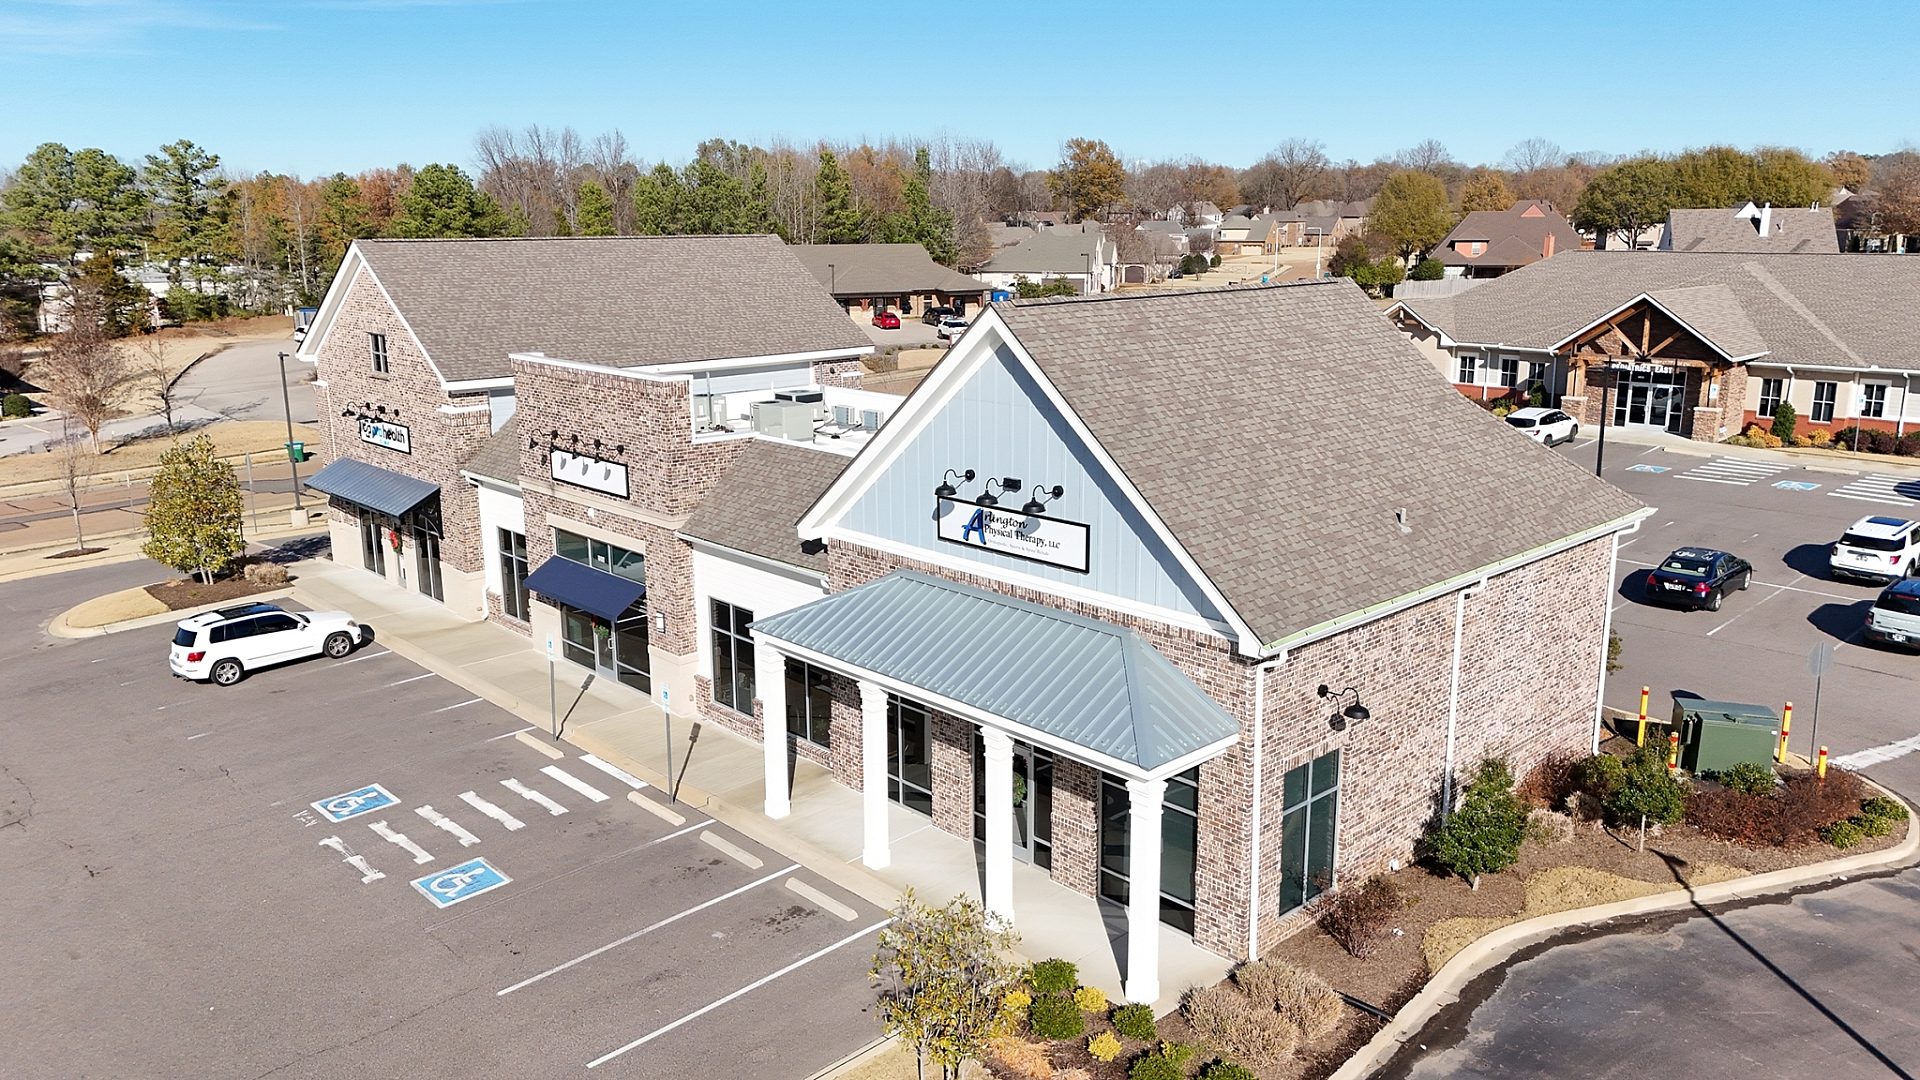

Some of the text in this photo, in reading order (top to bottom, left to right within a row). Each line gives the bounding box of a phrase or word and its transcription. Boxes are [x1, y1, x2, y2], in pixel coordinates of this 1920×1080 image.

[1655, 366, 1673, 374] EAST
[961, 508, 1028, 545] Arlington
[984, 523, 1013, 538] Physical
[1015, 530, 1047, 548] Therapy,
